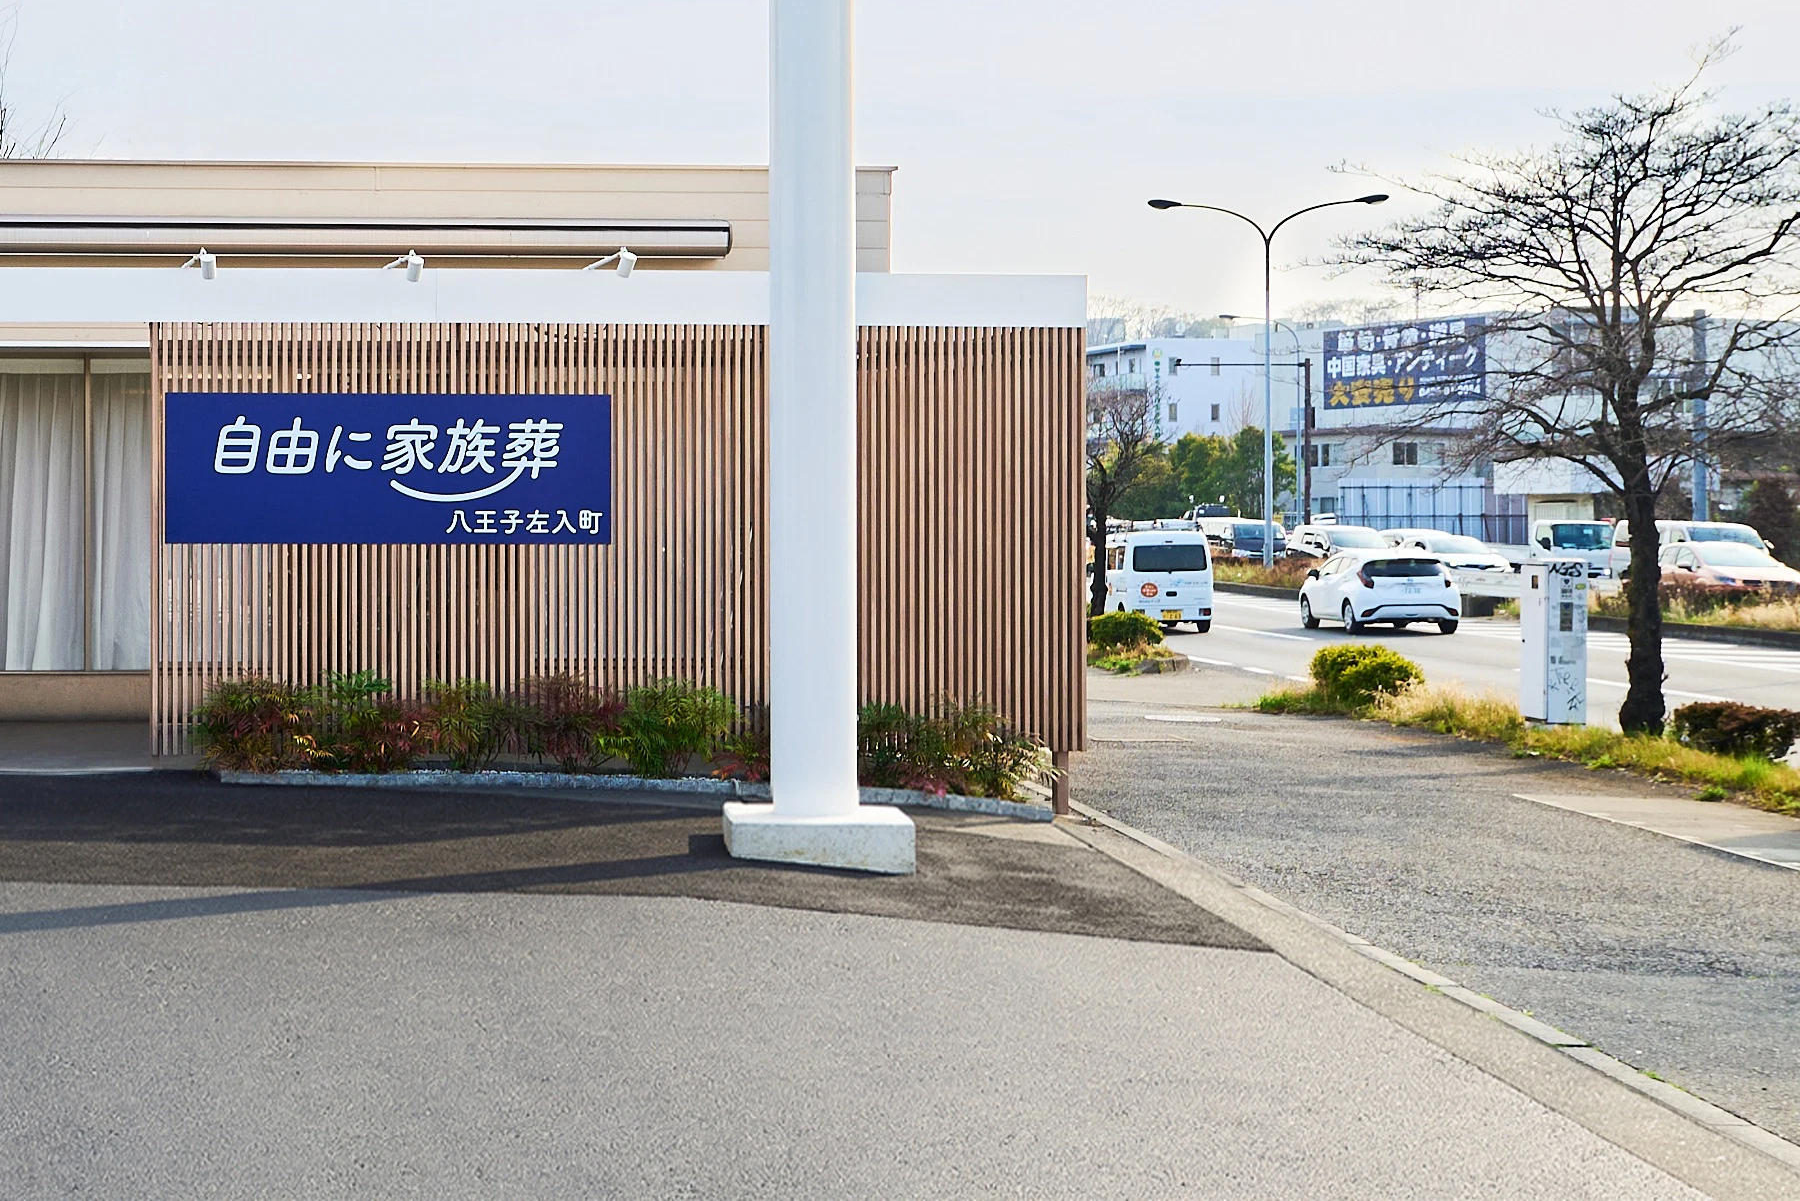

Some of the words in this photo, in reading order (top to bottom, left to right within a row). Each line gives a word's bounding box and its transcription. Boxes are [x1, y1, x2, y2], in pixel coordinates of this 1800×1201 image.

[213, 415, 564, 480] 自由に家族葬
[445, 509, 603, 535] 八王子左入町
